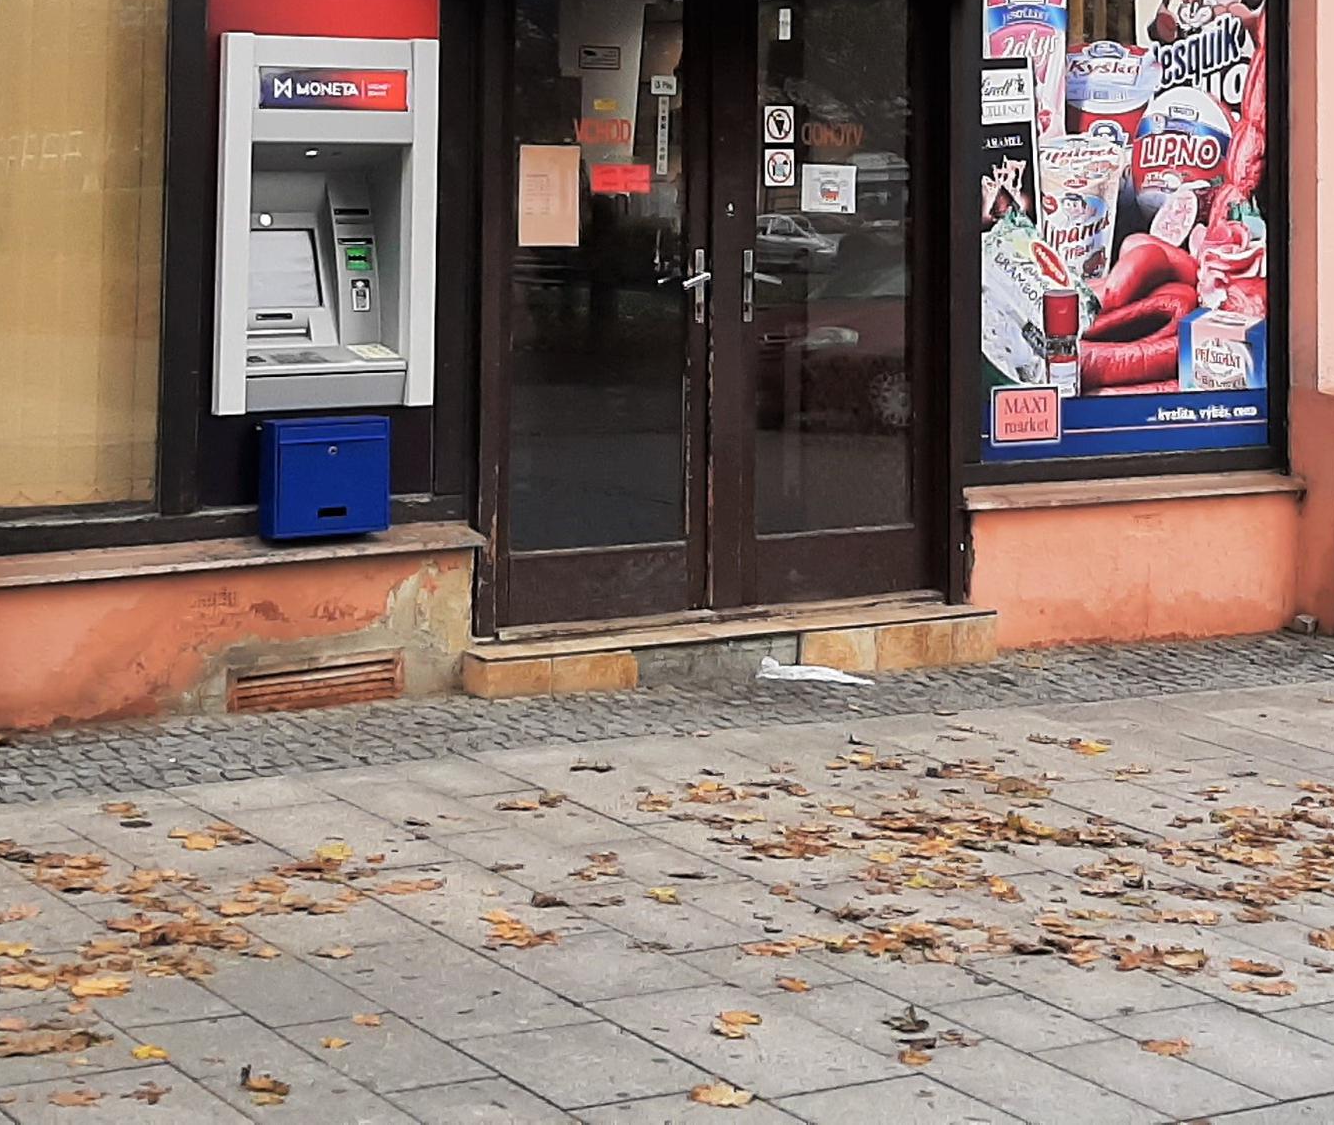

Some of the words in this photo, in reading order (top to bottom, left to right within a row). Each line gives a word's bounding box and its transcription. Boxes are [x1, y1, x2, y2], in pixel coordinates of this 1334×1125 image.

[296, 81, 359, 97] MONETA
[1140, 135, 1222, 168] LIPNO
[1005, 396, 1047, 414] MAXI
[1004, 417, 1048, 435] market
